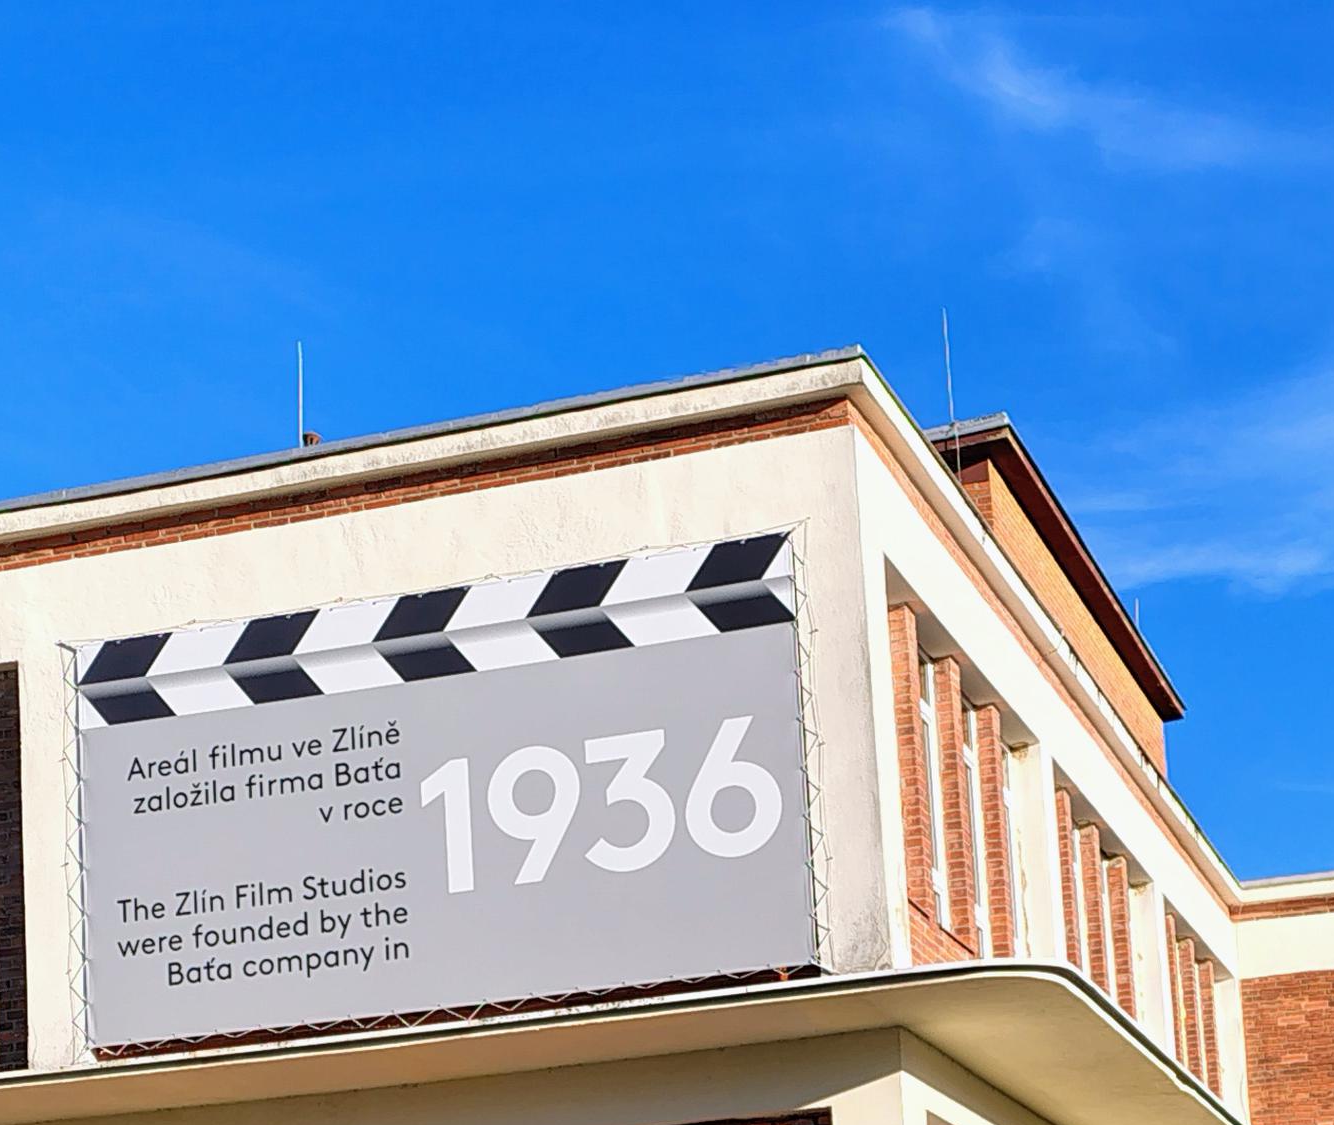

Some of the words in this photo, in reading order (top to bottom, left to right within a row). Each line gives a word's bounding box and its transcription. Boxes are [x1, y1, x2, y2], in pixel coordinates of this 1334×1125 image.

[127, 749, 198, 782] Areál
[209, 743, 283, 770] filmu
[292, 739, 323, 758] ve
[332, 720, 401, 753] Zlíně
[133, 780, 236, 814] založila
[245, 772, 323, 799] firma
[335, 757, 401, 787] Baťa
[319, 805, 334, 823] v
[344, 796, 404, 821] roce
[419, 714, 784, 894] 1936
[117, 898, 166, 923] The
[175, 888, 225, 917] Zlín
[235, 882, 293, 910] Film
[302, 868, 407, 901] Studios
[117, 934, 183, 957] were
[192, 911, 309, 948] founded
[320, 909, 352, 939] by
[360, 902, 409, 928] the
[168, 957, 232, 986] Baťa
[243, 945, 375, 978] company
[384, 937, 410, 960] in
